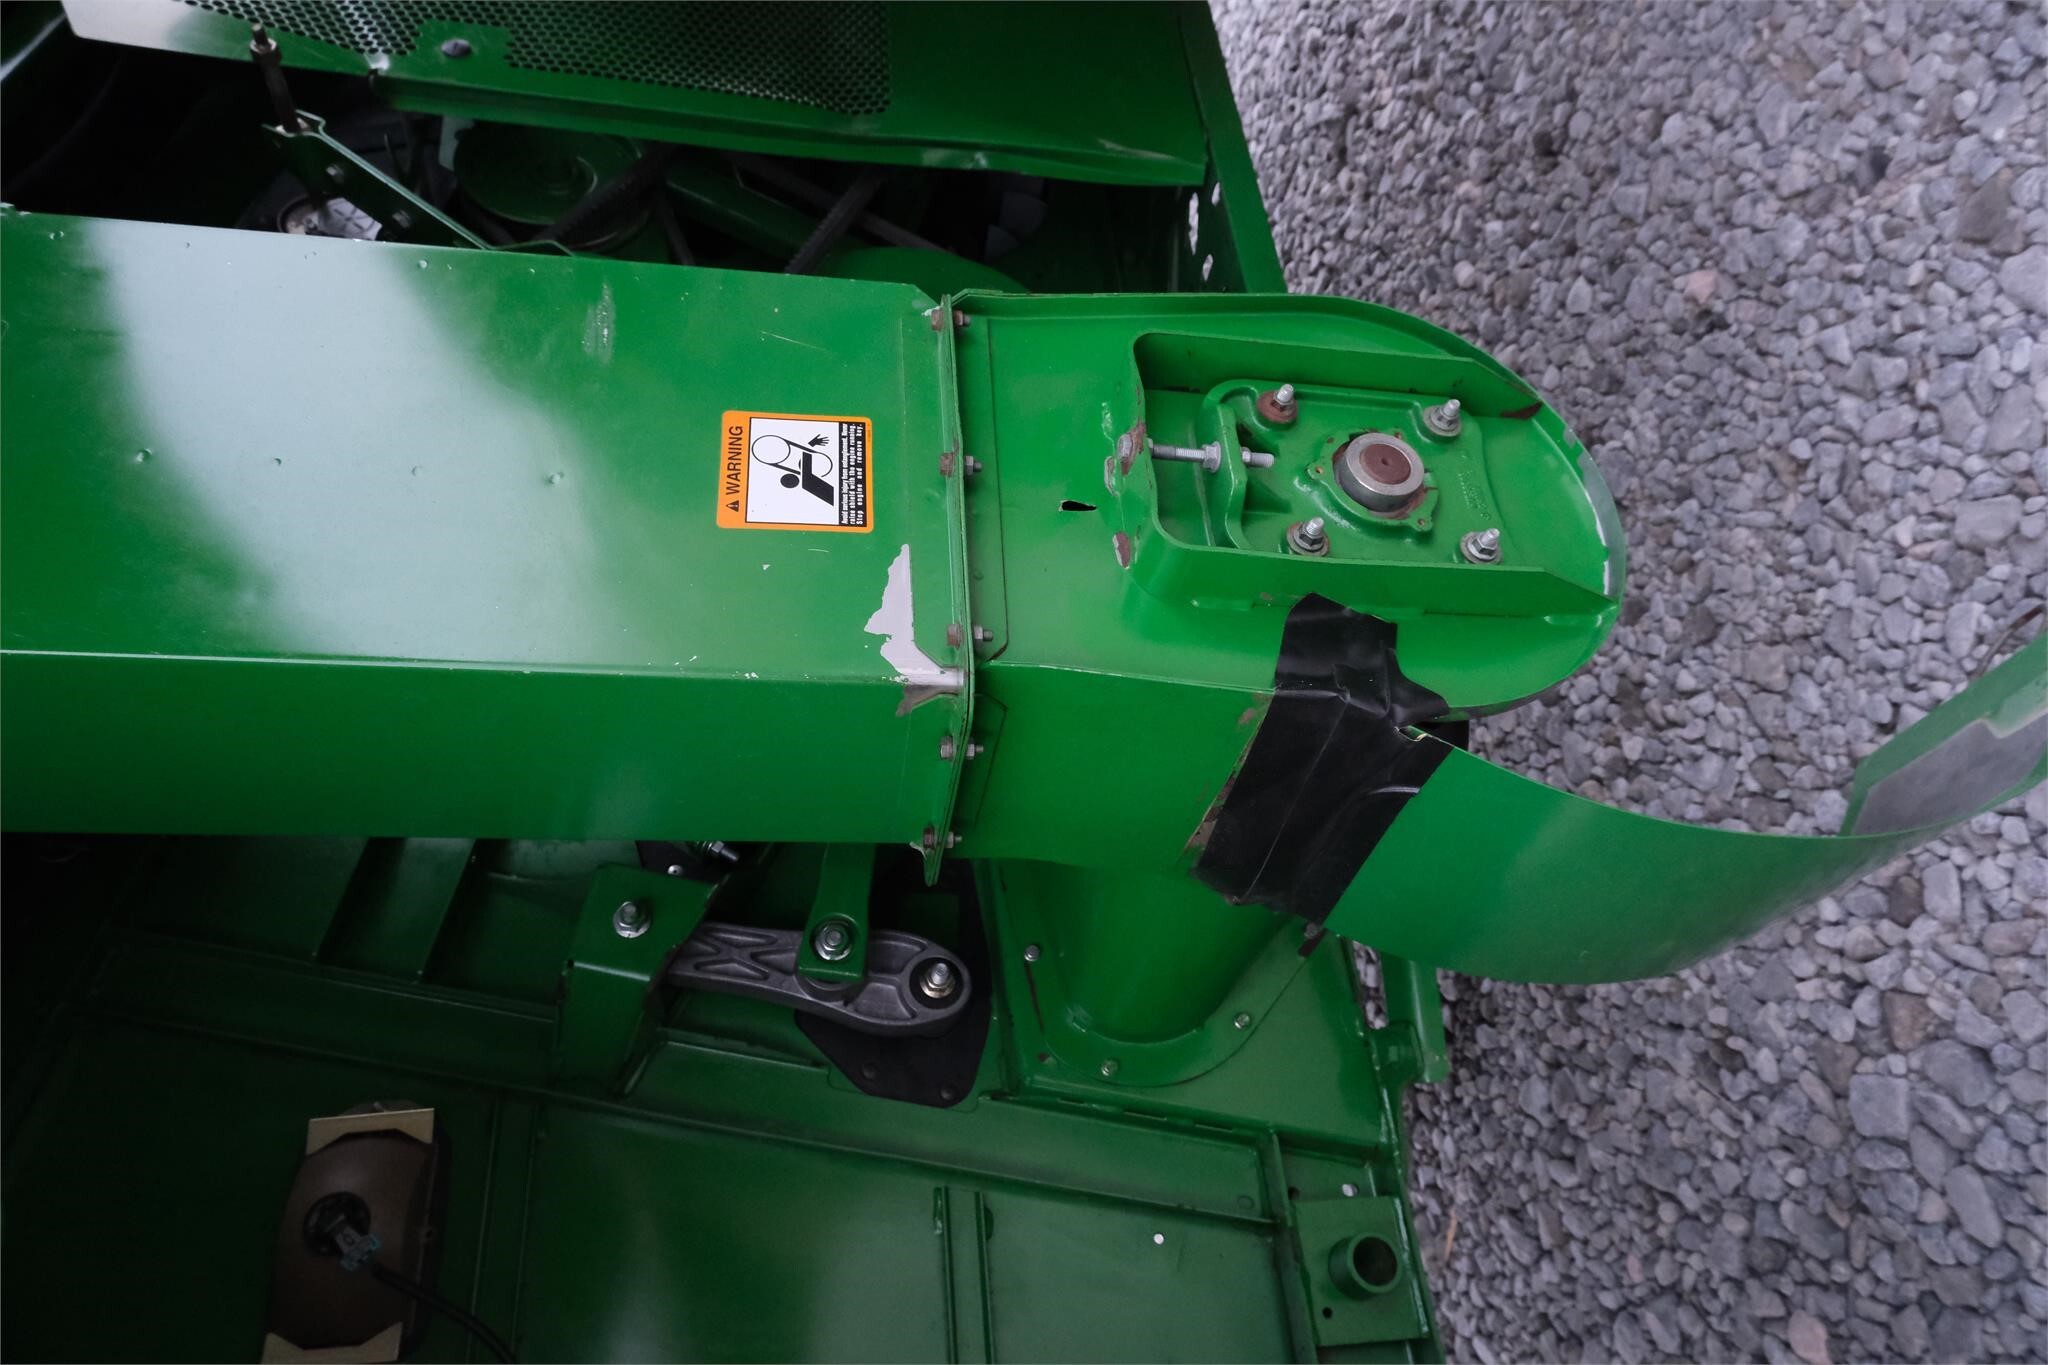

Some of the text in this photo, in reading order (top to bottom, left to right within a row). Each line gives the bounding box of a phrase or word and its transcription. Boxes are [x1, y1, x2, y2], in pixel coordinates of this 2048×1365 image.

[725, 425, 743, 495] WARNING
[856, 484, 864, 505] engine
[856, 510, 864, 525] Stop
